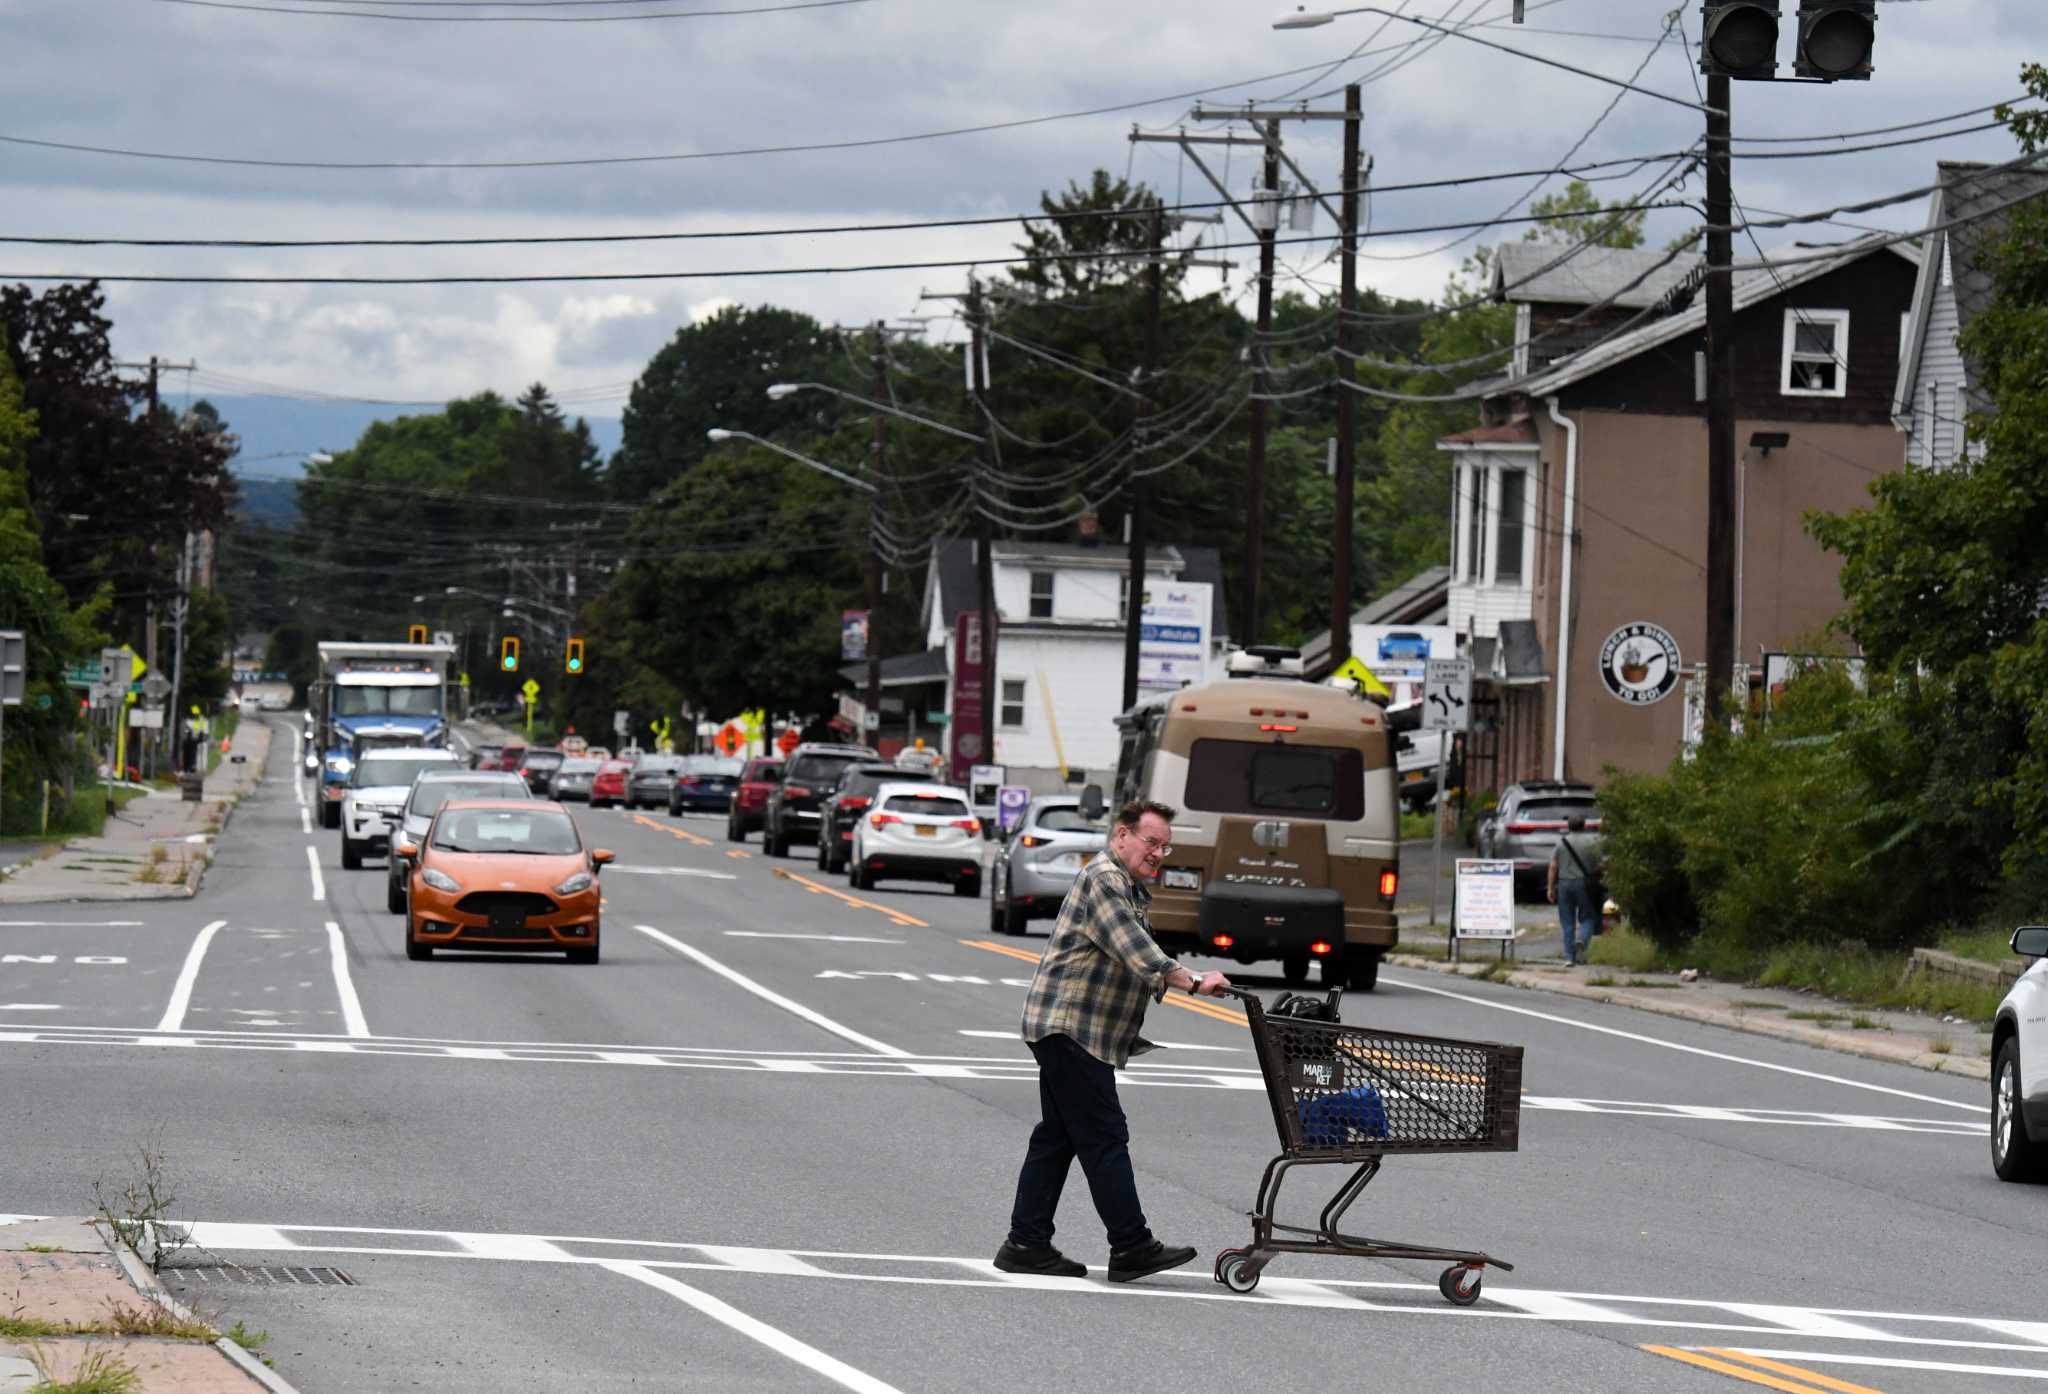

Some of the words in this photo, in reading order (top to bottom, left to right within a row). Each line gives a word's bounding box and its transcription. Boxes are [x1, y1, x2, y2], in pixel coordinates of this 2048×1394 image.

[1603, 630, 1628, 669] LUNCH
[1644, 626, 1679, 671] DINNER
[1619, 687, 1634, 700] TO
[1638, 687, 1660, 700] GO!
